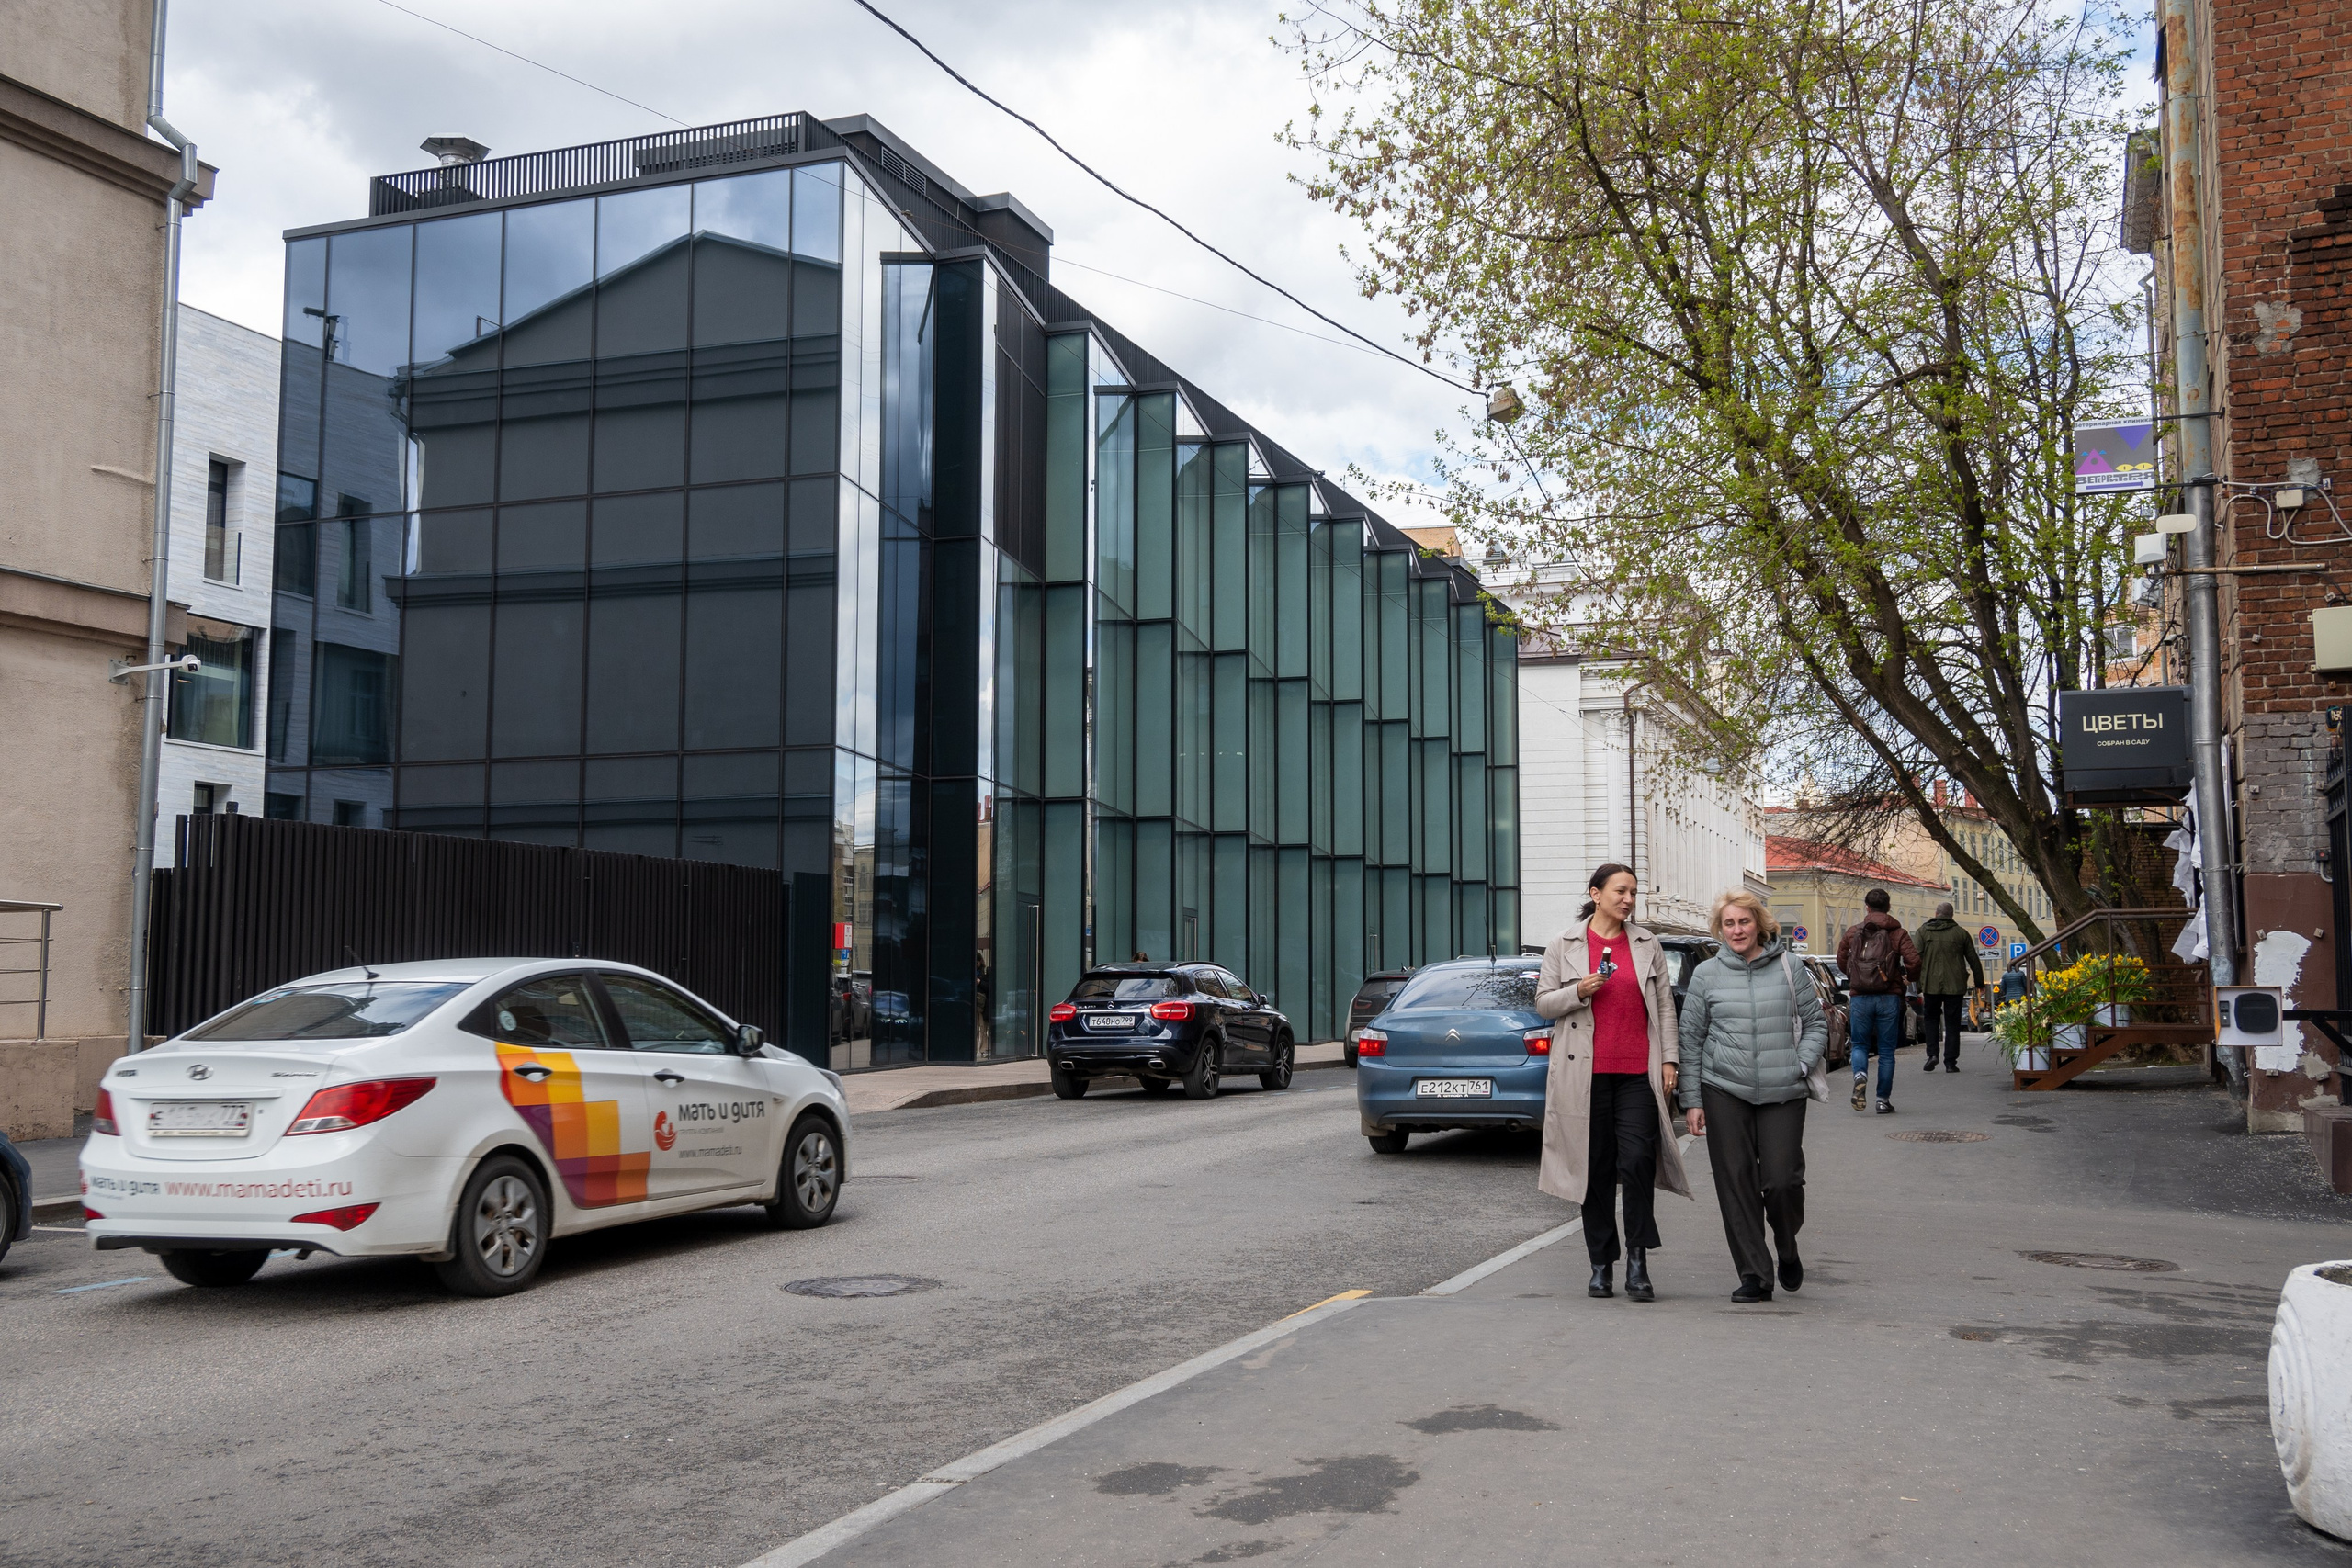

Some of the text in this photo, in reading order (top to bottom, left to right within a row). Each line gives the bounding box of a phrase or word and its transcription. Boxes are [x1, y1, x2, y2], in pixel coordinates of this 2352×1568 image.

[2082, 713, 2163, 734] ЦВЕТЫ
[1470, 1080, 1487, 1090] 761
[164, 1178, 354, 1199] www.mamadeti.ru
